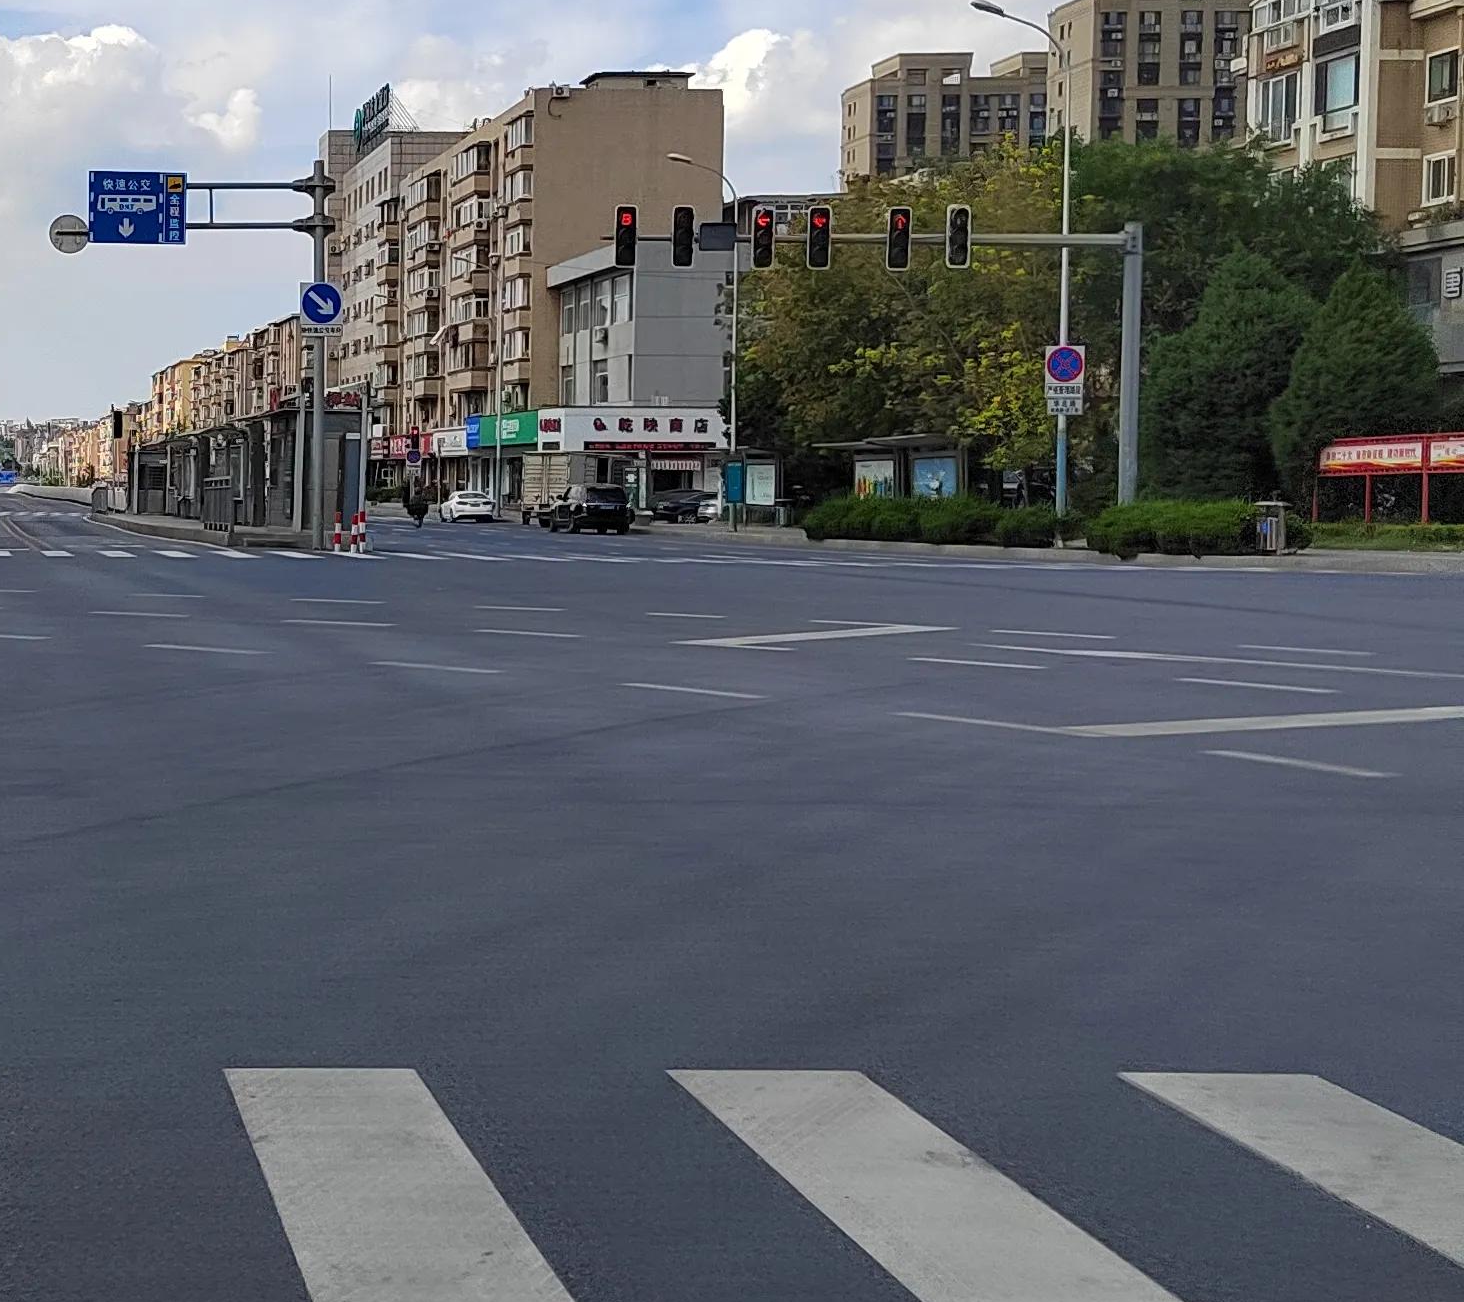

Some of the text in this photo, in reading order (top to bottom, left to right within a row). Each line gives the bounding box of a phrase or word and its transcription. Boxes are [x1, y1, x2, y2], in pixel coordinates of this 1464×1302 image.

[103, 179, 151, 191] 快速公交
[169, 194, 181, 241] 全程监控
